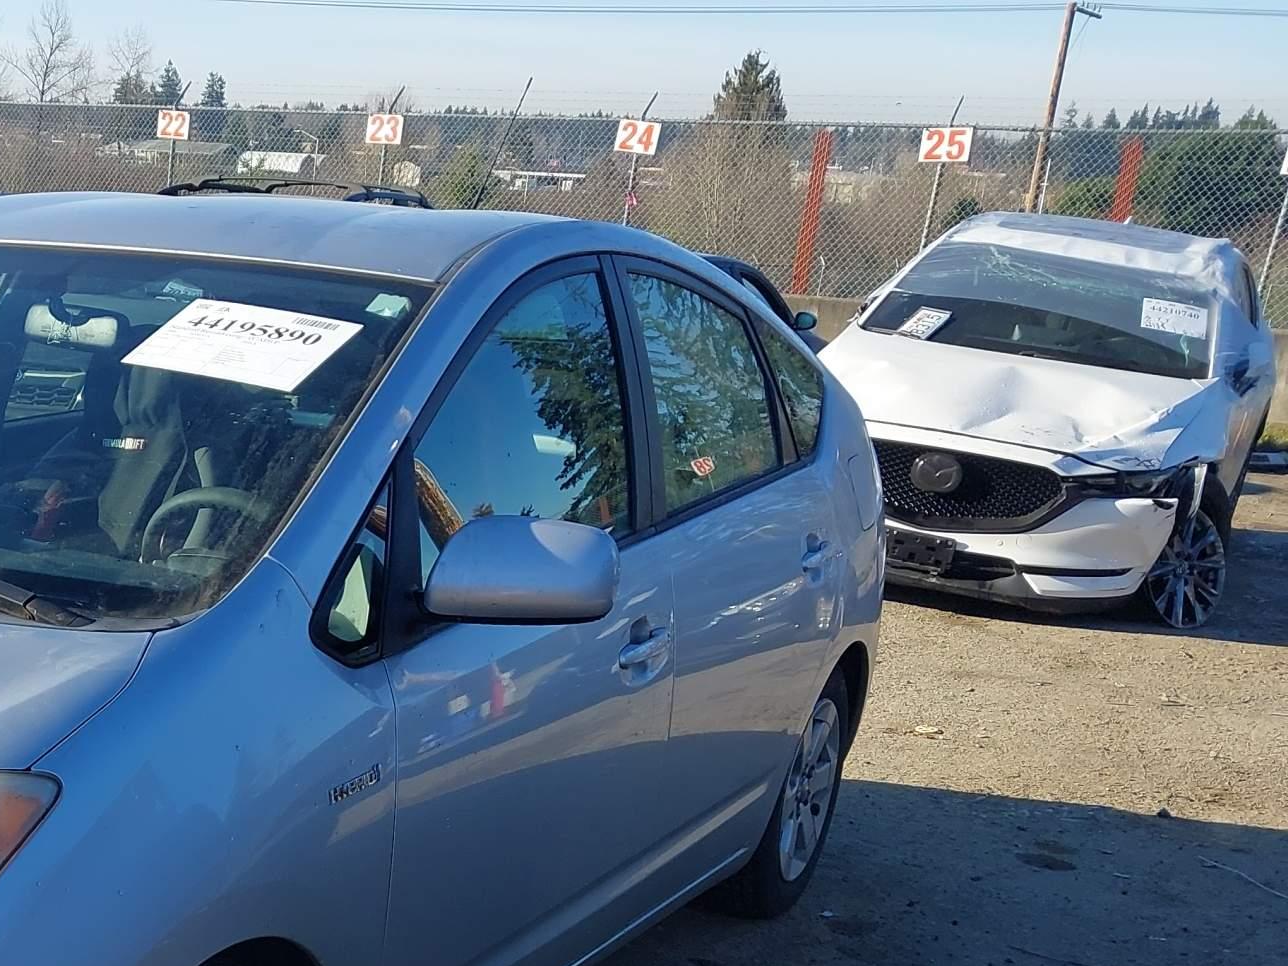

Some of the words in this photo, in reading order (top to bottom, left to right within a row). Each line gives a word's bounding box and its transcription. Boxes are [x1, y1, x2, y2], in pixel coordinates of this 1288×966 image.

[160, 111, 186, 137] 22
[369, 115, 400, 142] 23
[618, 121, 655, 152] 24
[923, 129, 967, 162] 25
[1150, 304, 1200, 320] 44210740
[187, 314, 324, 346] 44195890
